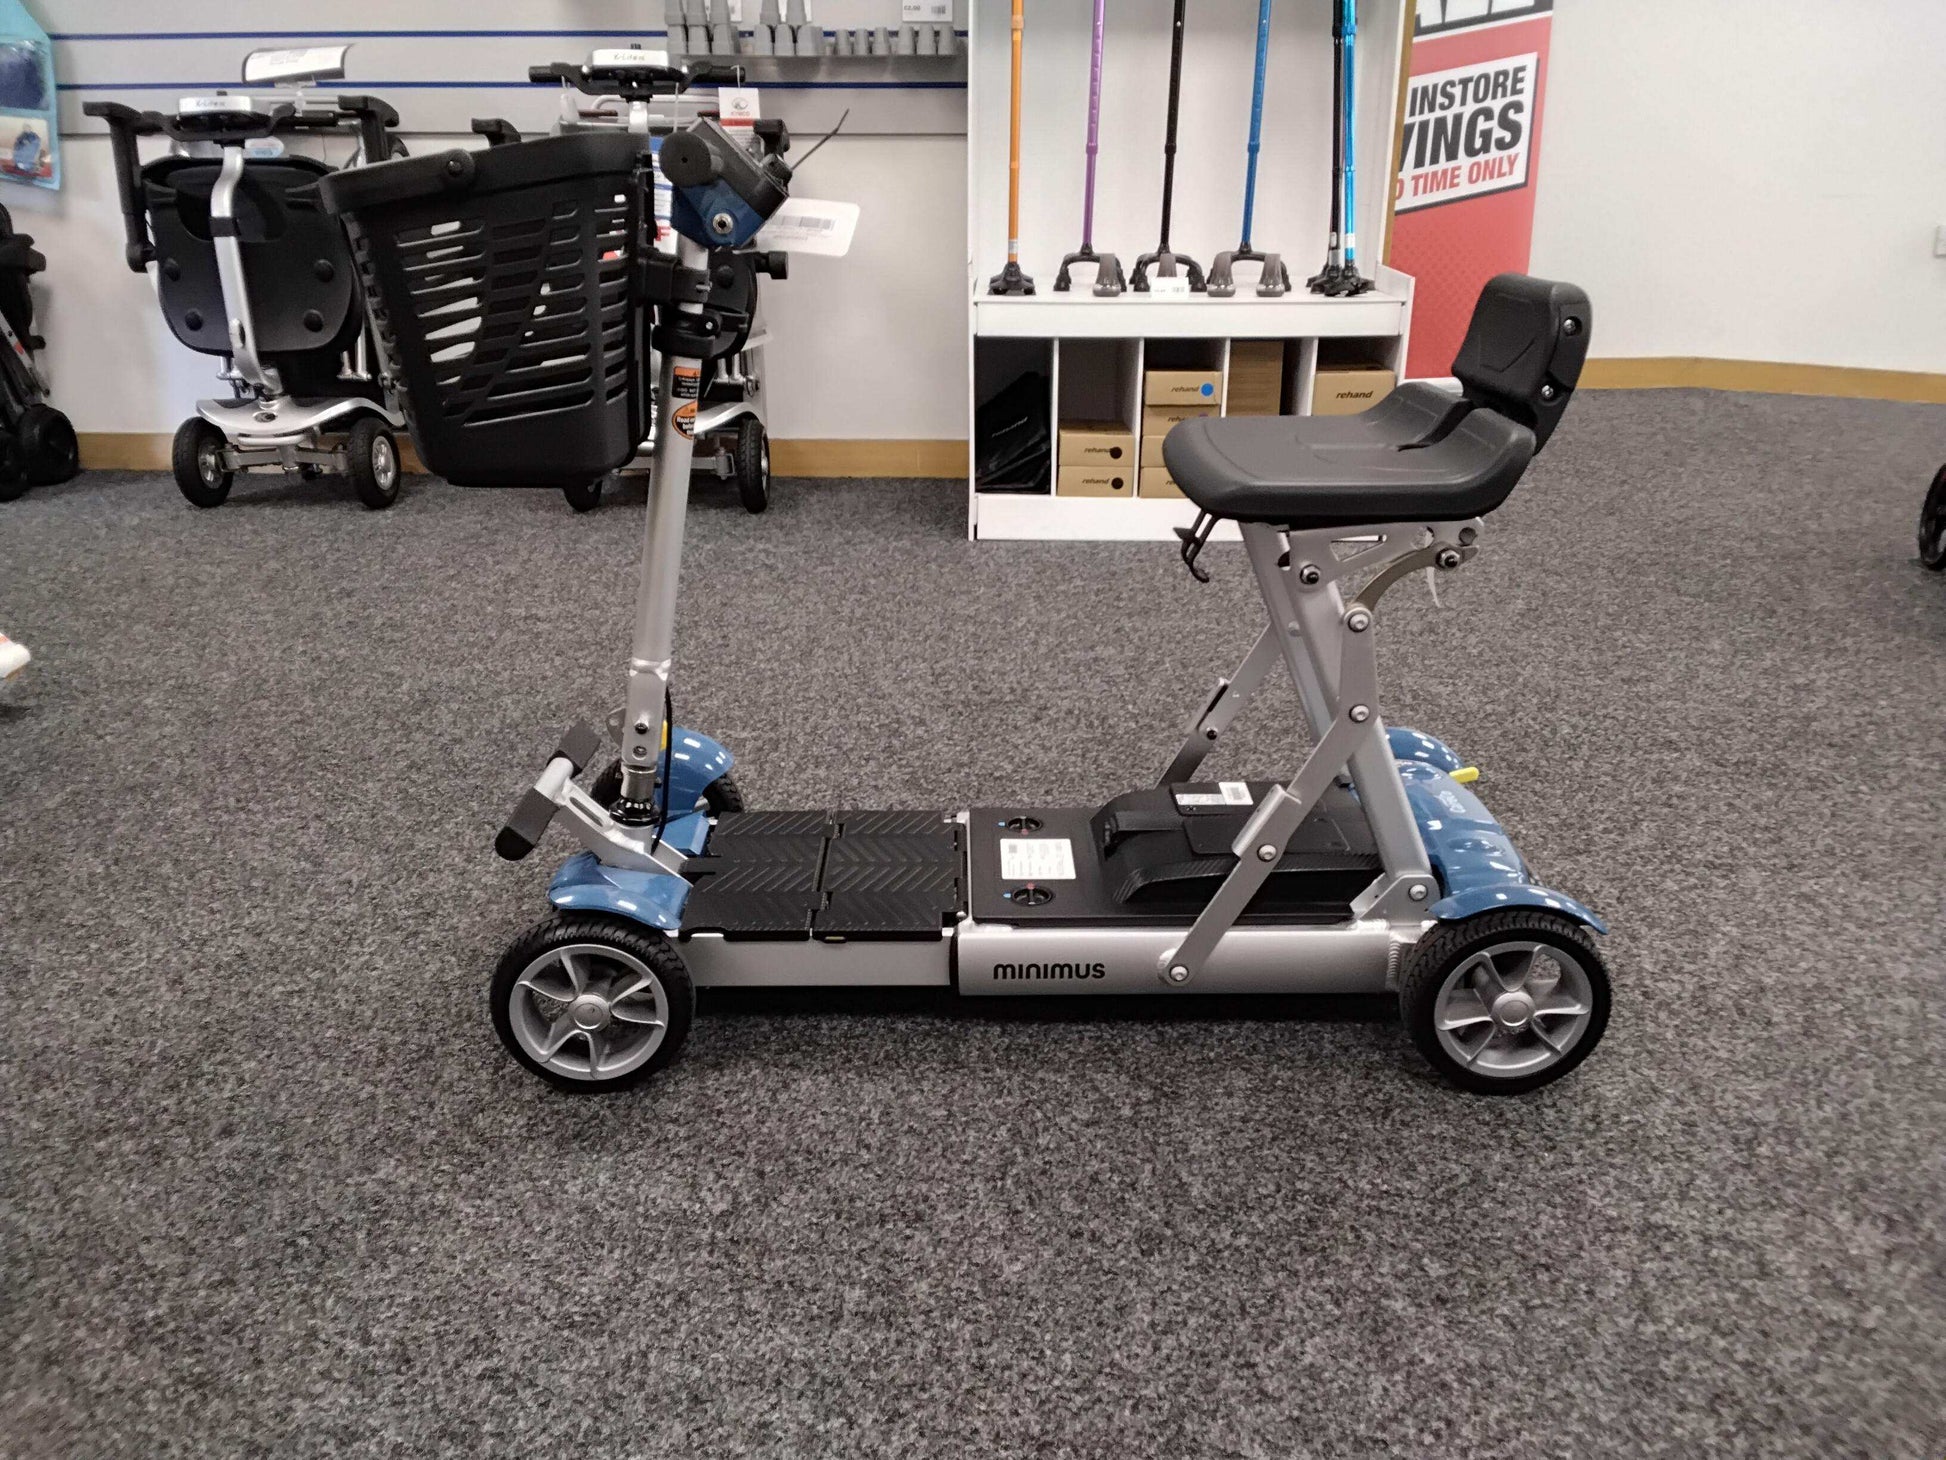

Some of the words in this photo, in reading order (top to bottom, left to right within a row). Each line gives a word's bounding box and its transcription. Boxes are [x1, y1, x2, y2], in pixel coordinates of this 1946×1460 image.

[1408, 64, 1527, 118] INSTORE
[1411, 166, 1461, 197] TIME
[1468, 152, 1520, 185] ONLY
[1336, 391, 1374, 399] rehand
